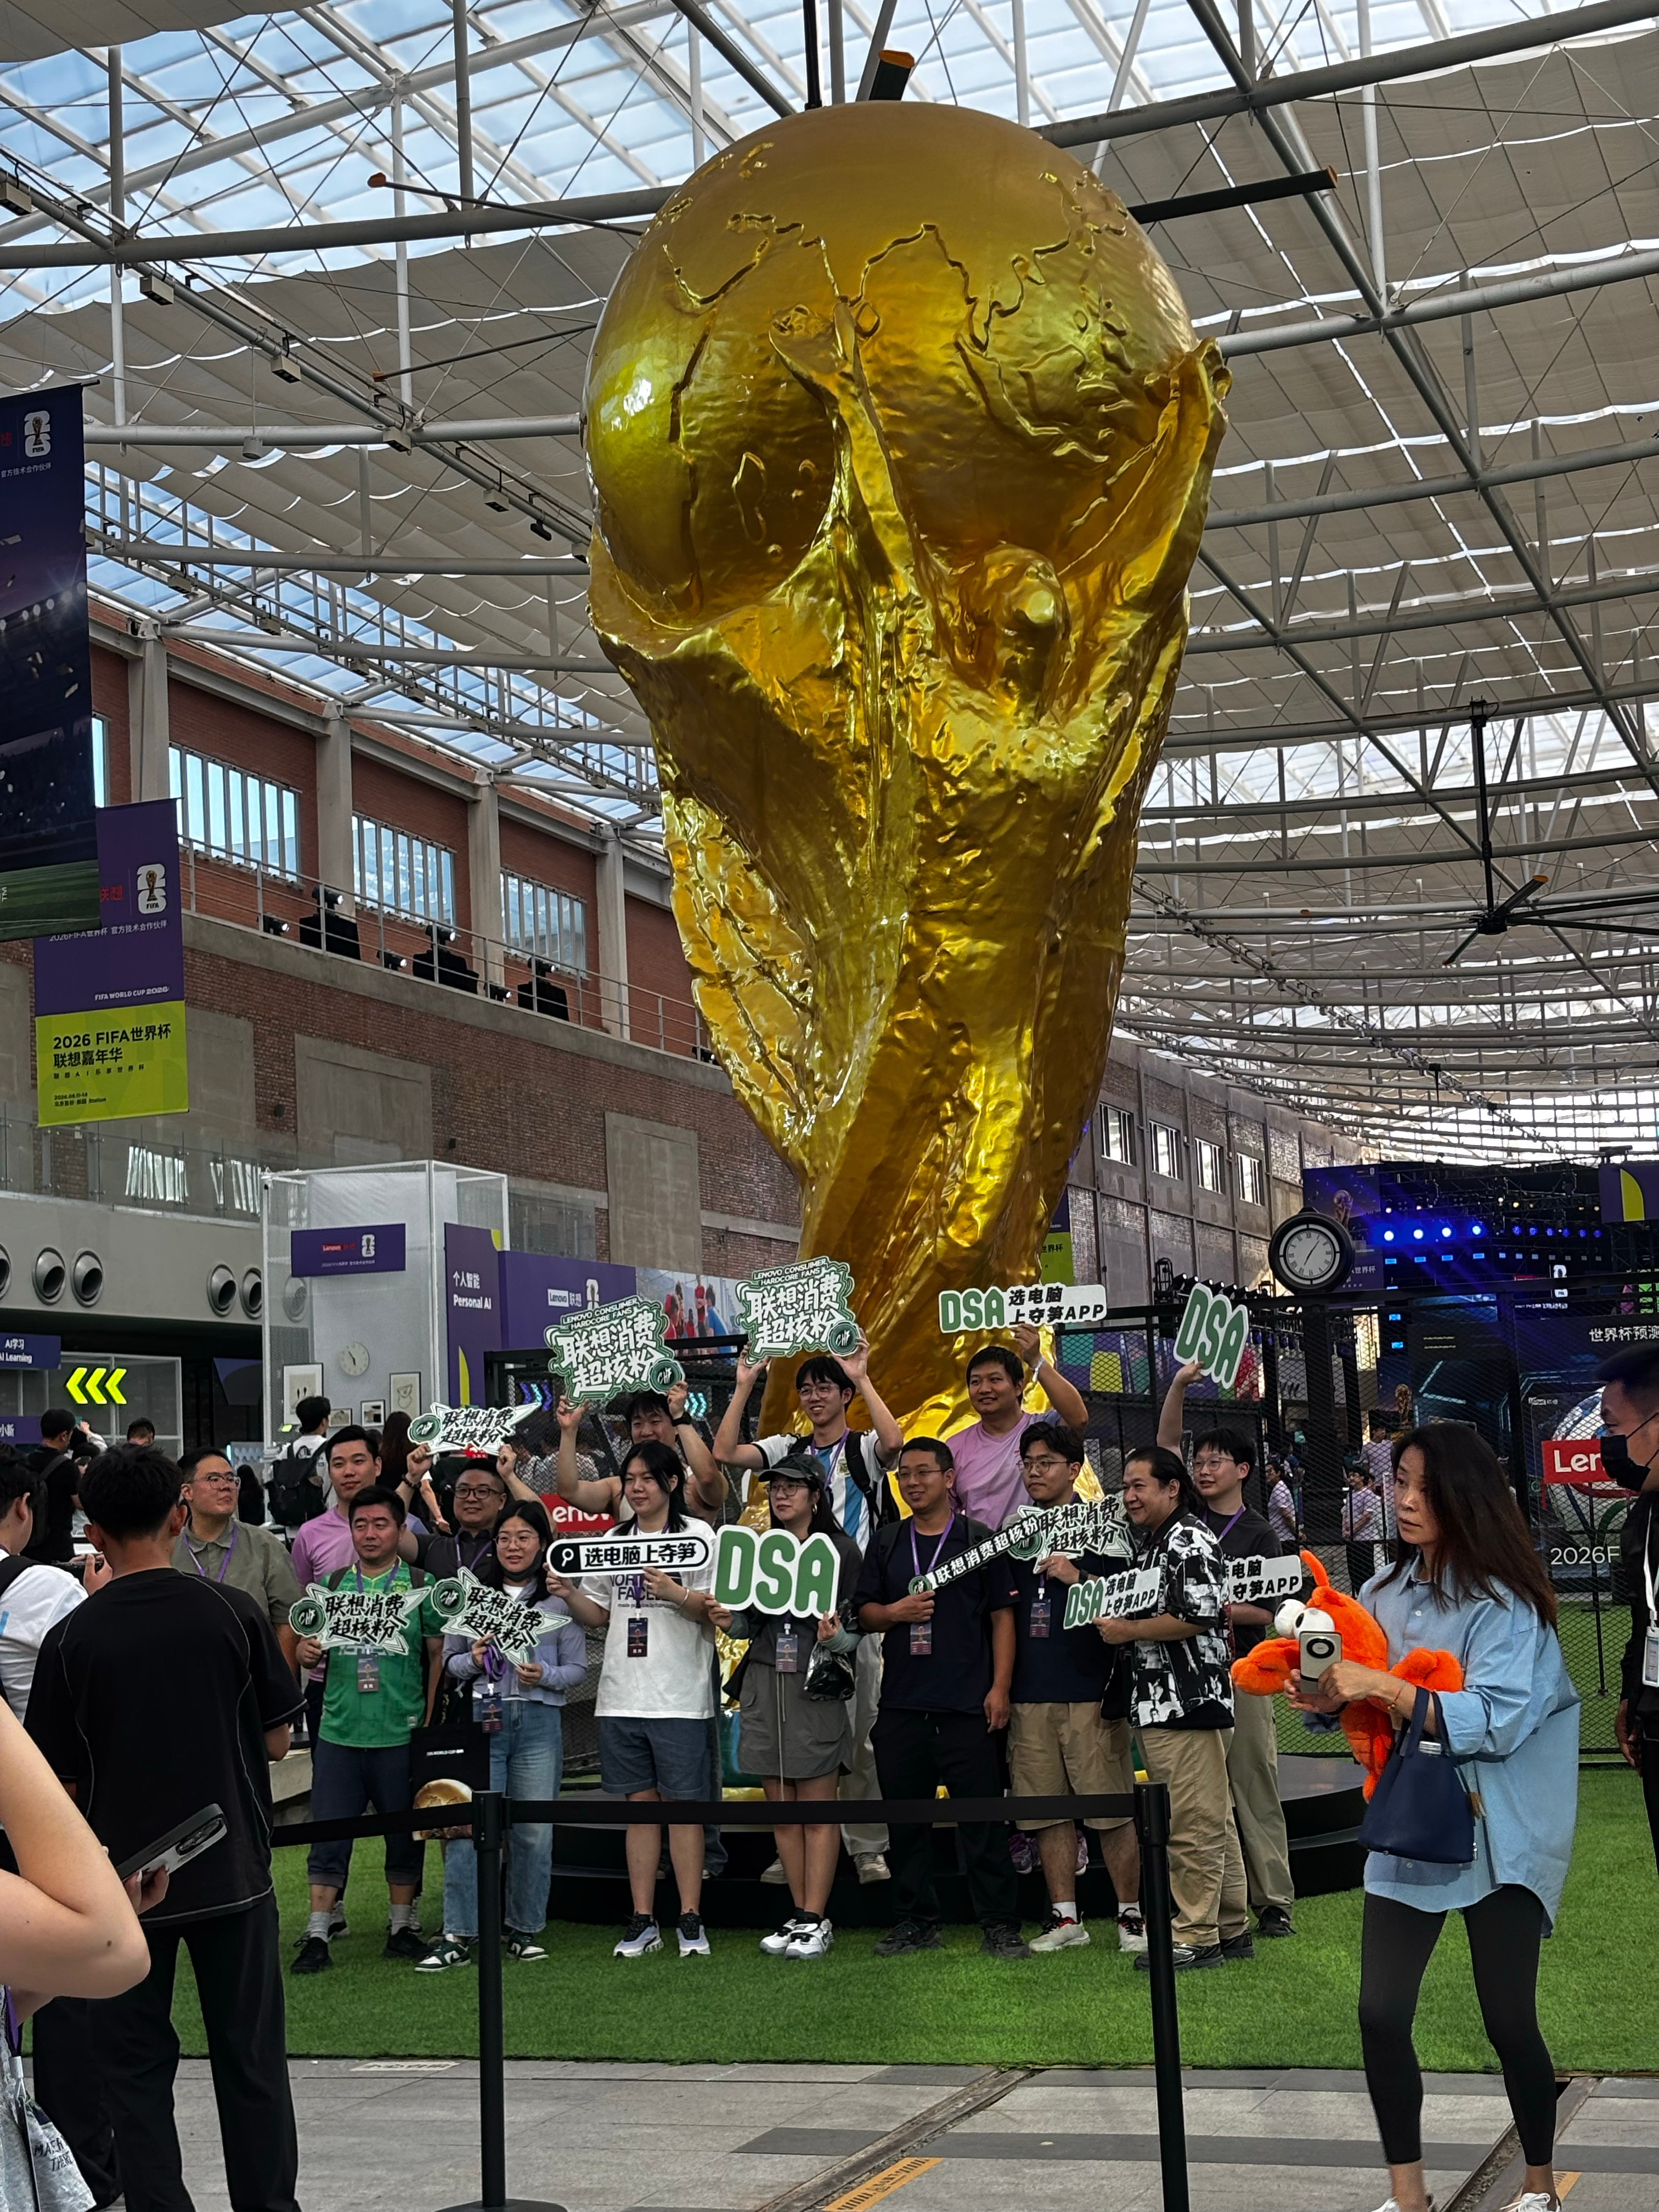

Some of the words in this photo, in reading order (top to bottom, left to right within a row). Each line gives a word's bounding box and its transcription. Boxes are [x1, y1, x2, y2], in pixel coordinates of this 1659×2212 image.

[111, 919, 167, 935] 官方技术合作伙伴
[109, 991, 132, 999] WORLD
[53, 1034, 91, 1049] 2026
[96, 1023, 171, 1045] FIFA世界杯
[53, 1047, 123, 1069] 联想嘉年华
[453, 1271, 480, 1289] 个人智能
[753, 1268, 782, 1280] LENOVO
[760, 1273, 799, 1286] HARDCORE
[801, 1267, 820, 1278] FANS
[453, 1293, 483, 1309] Personal
[484, 1297, 492, 1310] AI
[550, 1292, 567, 1304] Lenovo
[746, 1271, 842, 1324] 联想消费
[1008, 1285, 1063, 1307] 选电脑
[563, 1310, 592, 1324] LENOVO
[571, 1315, 610, 1330] HARDCORE
[613, 1308, 633, 1319] FANS
[941, 1289, 1005, 1331] DSA
[1009, 1304, 1104, 1325] 上夺笋APP
[556, 1311, 657, 1369] 联想消费
[753, 1308, 847, 1353] 超核粉
[1176, 1288, 1244, 1384] DSA
[5, 1352, 32, 1364] Learning
[572, 1346, 665, 1398] 超核粉
[442, 1408, 515, 1434] 联想消费
[439, 1427, 504, 1448] 超核粉
[1039, 1496, 1126, 1534] 联想消费
[934, 1516, 1039, 1585] 联想消费超核粉
[1047, 1524, 1118, 1554] 超核粉
[584, 1542, 696, 1567] 选电脑上夺笋
[715, 1530, 835, 1614] DSA
[325, 1594, 409, 1627] 联想消费
[466, 1587, 543, 1646] 联想消费
[1065, 1579, 1104, 1628] DSA
[329, 1617, 399, 1644] 超核粉
[461, 1610, 528, 1651] 超核粉
